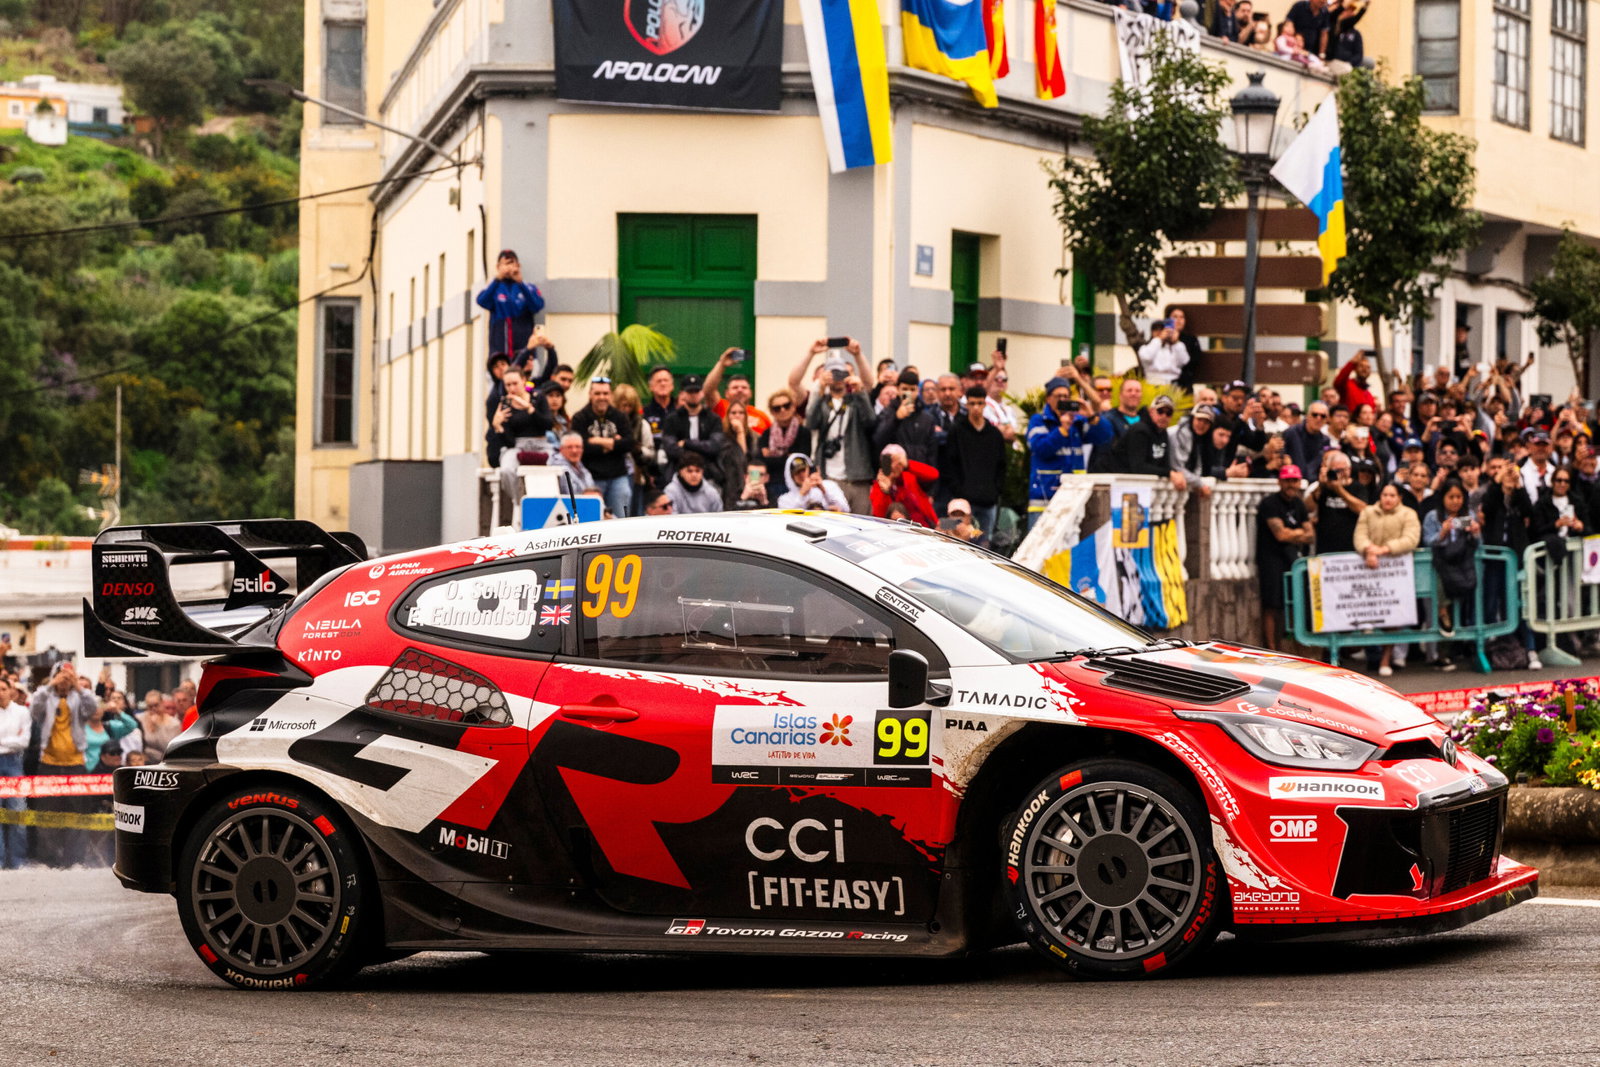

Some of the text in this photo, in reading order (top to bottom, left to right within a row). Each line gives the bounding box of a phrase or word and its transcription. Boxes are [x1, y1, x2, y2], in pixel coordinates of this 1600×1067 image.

[592, 60, 723, 85] APOLOCAN
[656, 529, 733, 544] PROTERIAL
[102, 554, 148, 563] SCHROTH
[388, 562, 421, 571] JAPAN
[387, 567, 435, 576] AIRLINES
[102, 582, 155, 596] DENSO
[234, 569, 276, 593] Stilo
[581, 553, 643, 619] 99
[1351, 582, 1381, 590] RALLY
[447, 580, 542, 604] O. Solberg
[1366, 590, 1395, 599] RALLY
[875, 588, 921, 620] CENTRAL
[124, 606, 160, 621] SWS
[407, 605, 537, 627] E. Edmondson
[957, 690, 1048, 710] TAMADIC
[267, 718, 317, 731] Microsoft
[773, 713, 817, 729] Islas
[945, 719, 988, 732] PIAA
[1266, 707, 1366, 735] codebeamer
[730, 727, 817, 746] Canarias
[876, 717, 928, 758] 99
[793, 751, 801, 759] DE
[802, 751, 816, 759] VIDA
[134, 771, 180, 787] ENDLESS
[731, 770, 760, 779] WRC
[1154, 735, 1237, 822] AUTOMOTIVE
[1163, 732, 1240, 816] Panasonic
[1269, 820, 1318, 837] OMP
[439, 827, 489, 855] Mobil
[745, 816, 845, 863] CCi
[1233, 892, 1300, 902] akebono
[706, 926, 776, 938] TOYOTA
[779, 927, 845, 939] GAZOO
[847, 930, 909, 942] Racing
